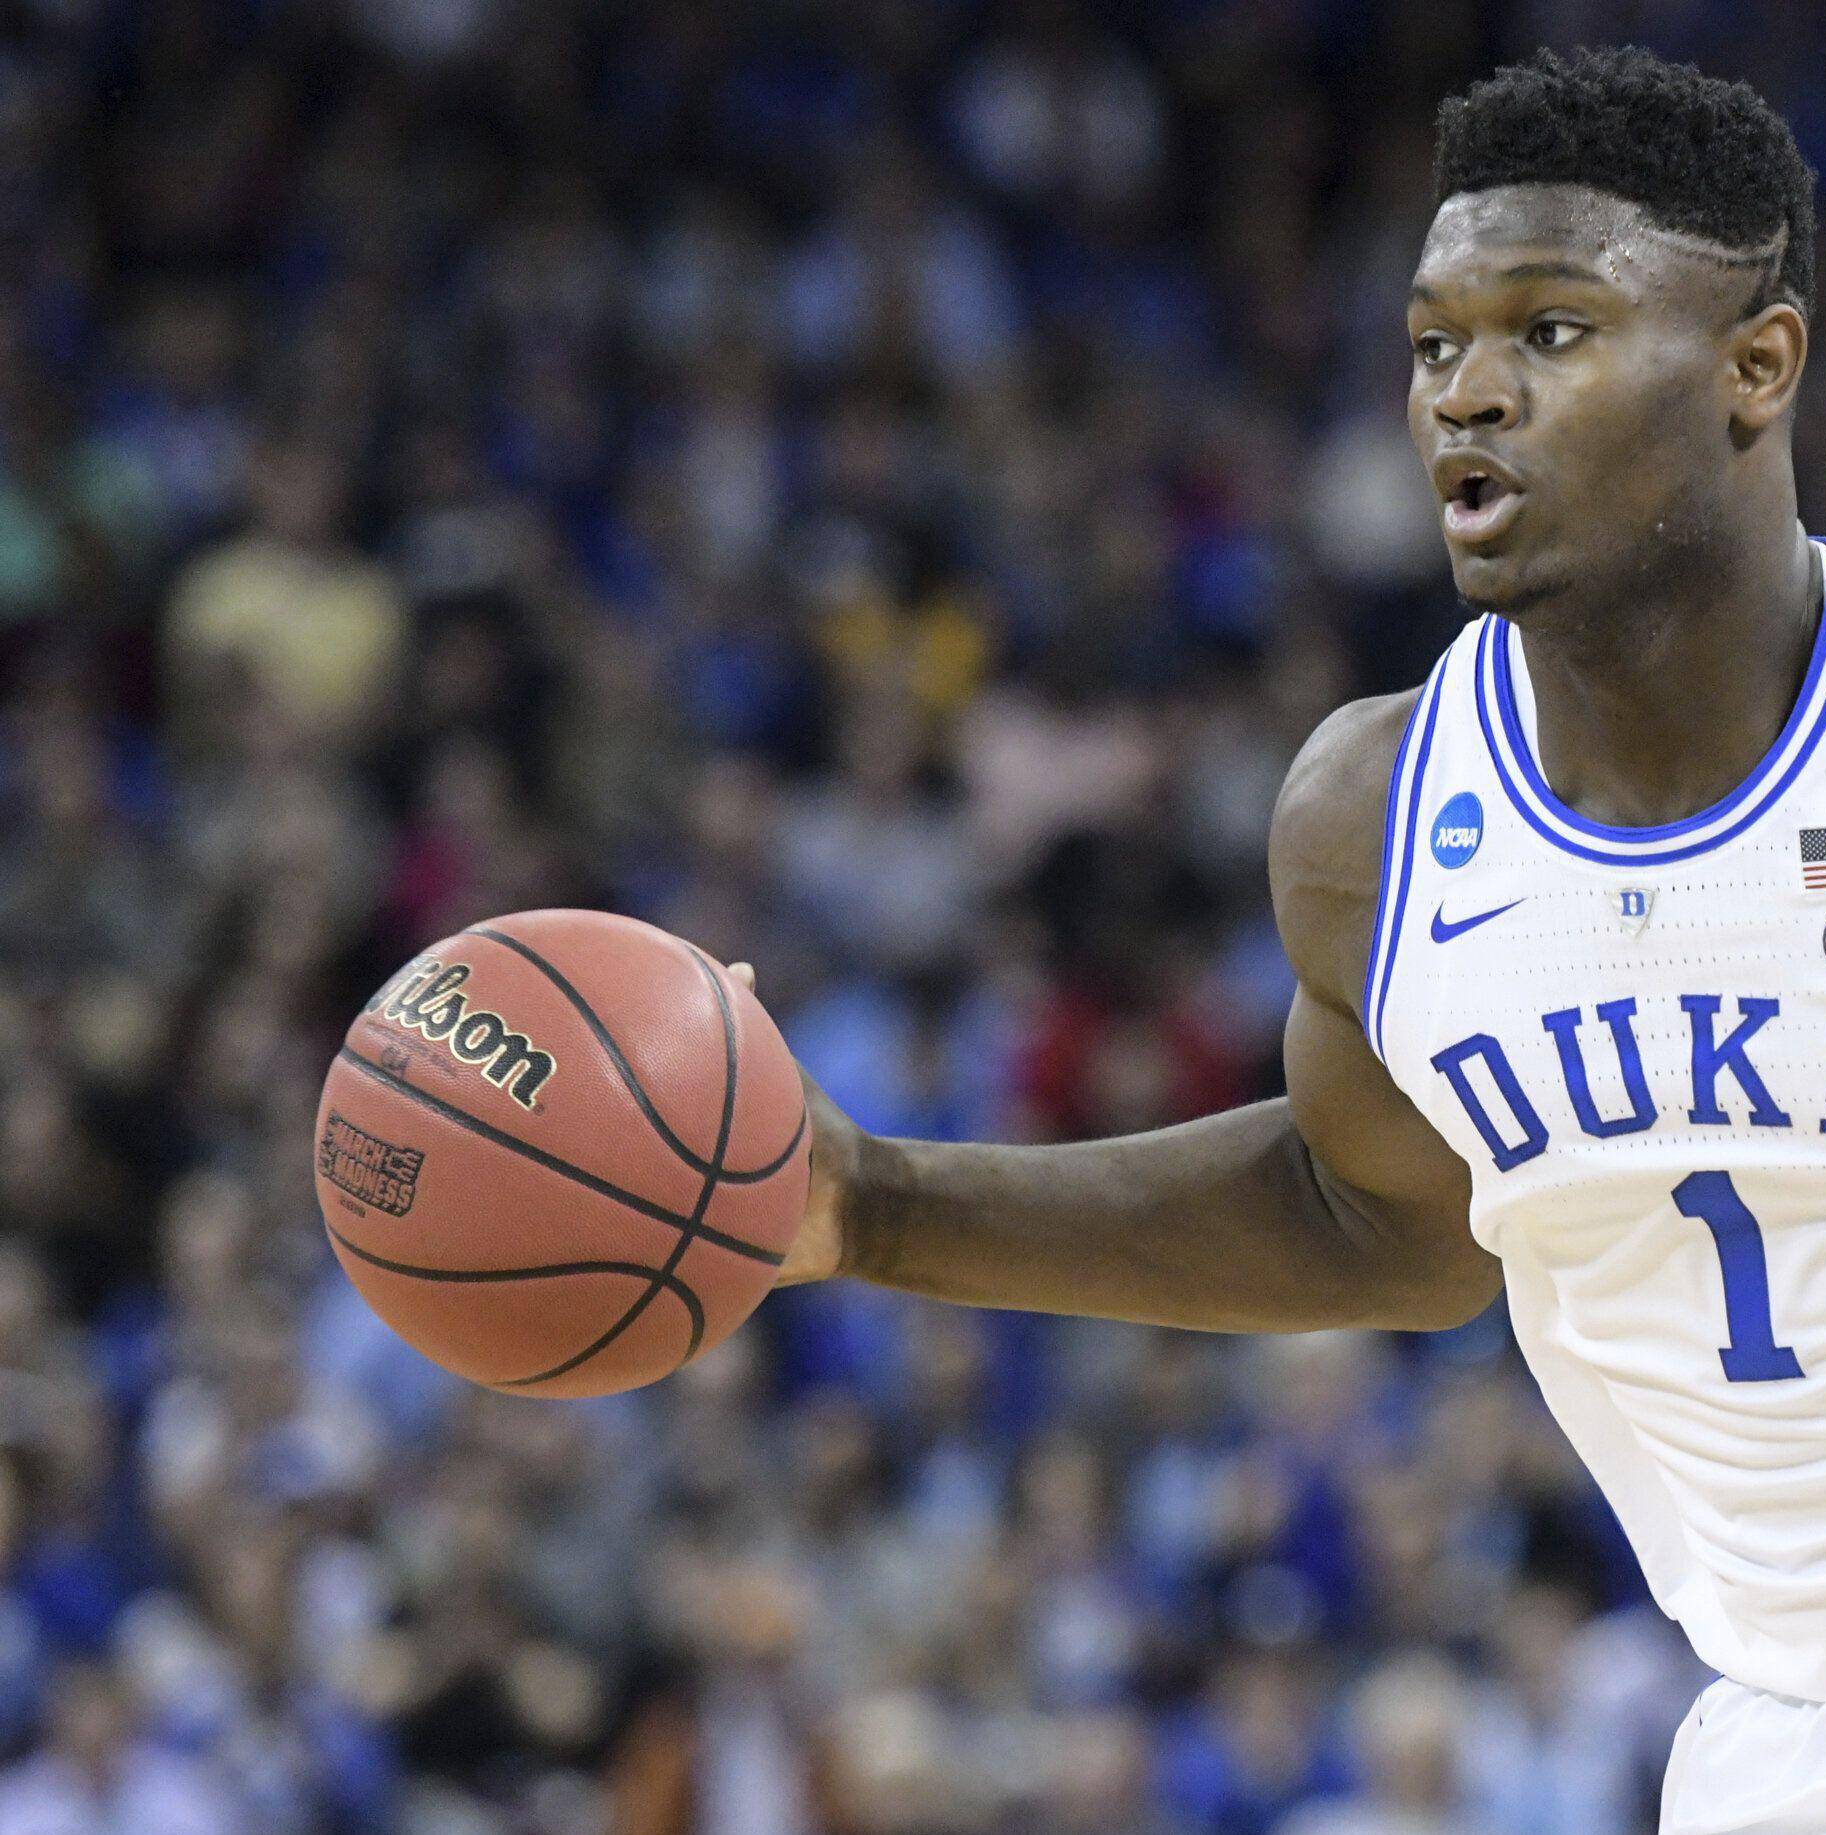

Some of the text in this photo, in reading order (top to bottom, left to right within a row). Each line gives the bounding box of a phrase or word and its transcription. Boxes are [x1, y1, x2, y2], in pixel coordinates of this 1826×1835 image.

[1436, 827, 1478, 849] NCAA
[1620, 889, 1646, 917] D
[333, 1151, 413, 1209] MADNESS
[1671, 1171, 1805, 1382] 1
